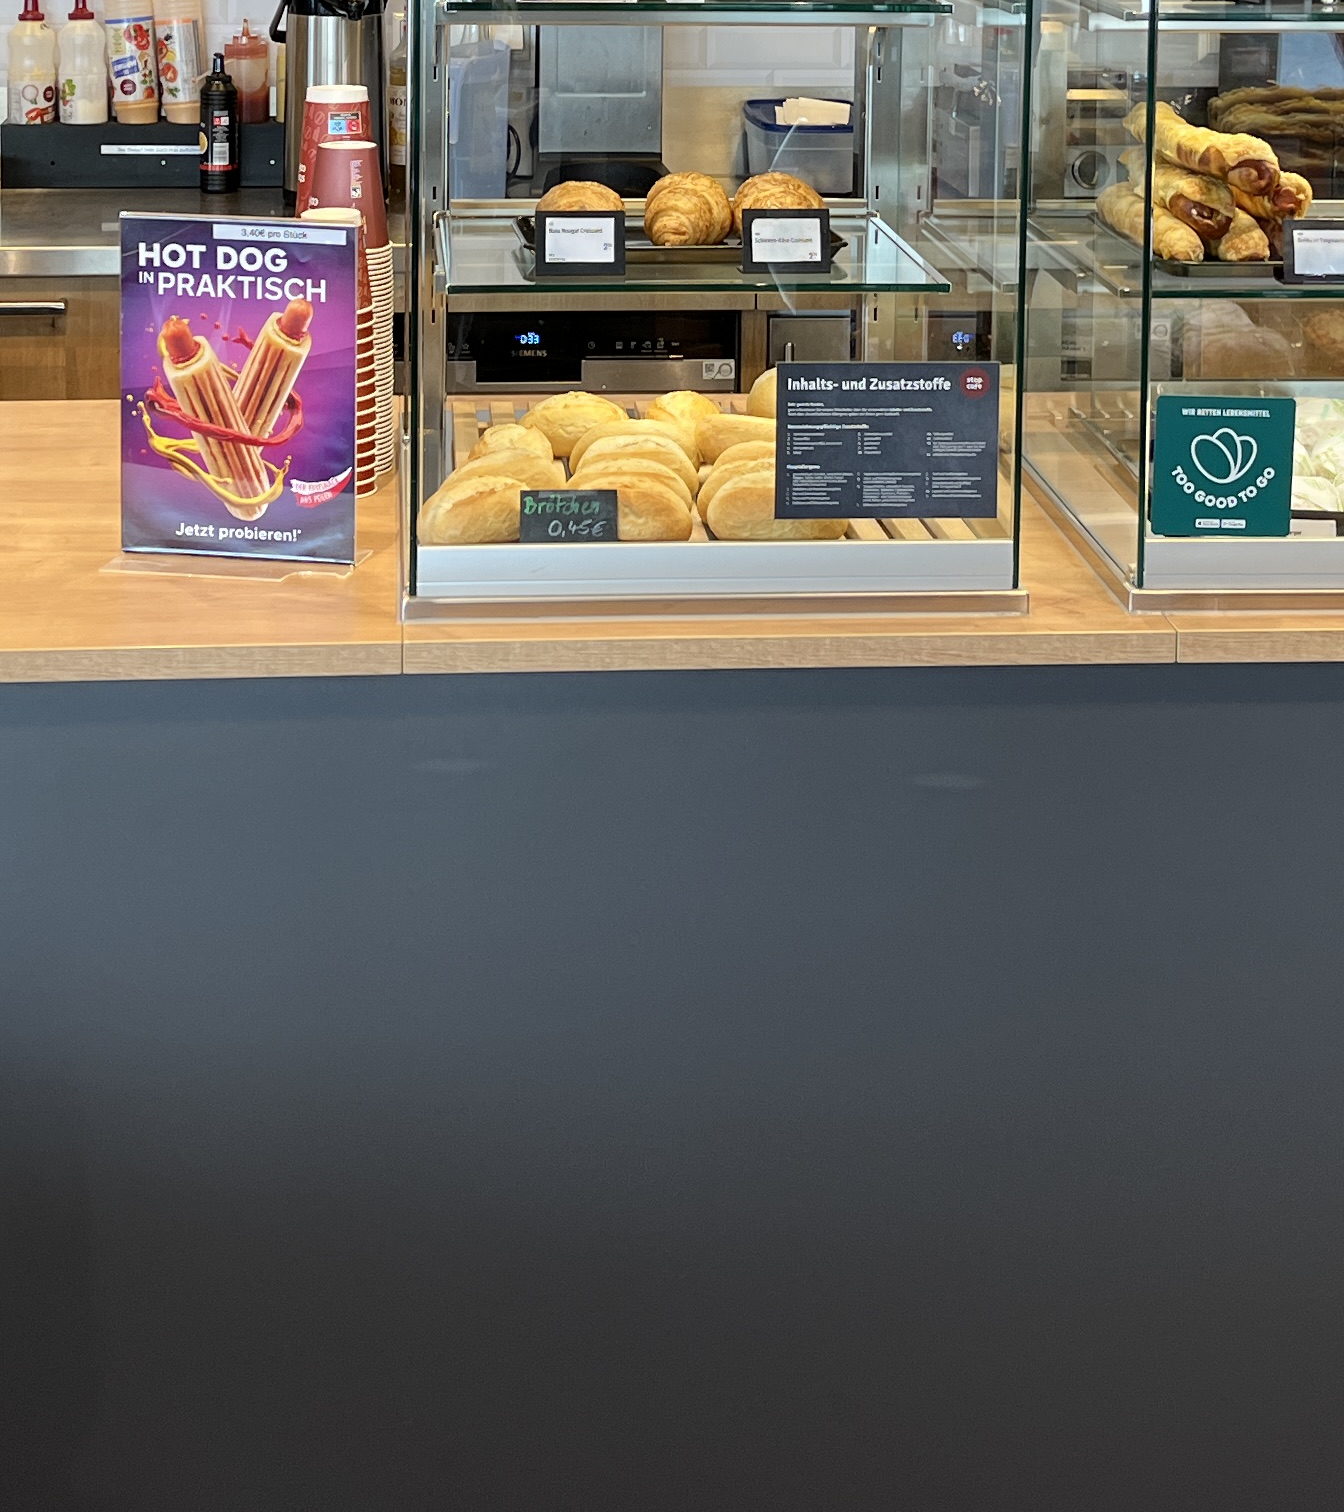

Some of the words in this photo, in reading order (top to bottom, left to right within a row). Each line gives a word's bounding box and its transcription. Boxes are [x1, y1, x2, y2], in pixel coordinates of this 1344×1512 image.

[267, 231, 281, 239] pro
[283, 229, 307, 240] Stück
[137, 242, 206, 270] HOT
[216, 245, 288, 273] DOG
[138, 271, 155, 284] IN
[158, 272, 327, 303] PRAKTISCH
[787, 377, 839, 391] Inhalts-
[841, 377, 866, 391] und
[869, 377, 952, 391] Zusatzstoffe
[1181, 407, 1196, 416] WIR
[1196, 408, 1222, 417] RETTEN
[1222, 408, 1271, 418] LEBENSMITTEL
[1171, 465, 1195, 494] TOO
[1194, 489, 1238, 509] GOOD
[1237, 485, 1258, 503] TO
[1256, 467, 1275, 488] GO
[523, 494, 601, 516] Brötchen
[175, 522, 215, 537] Jetzt
[548, 519, 607, 538] 0,45€
